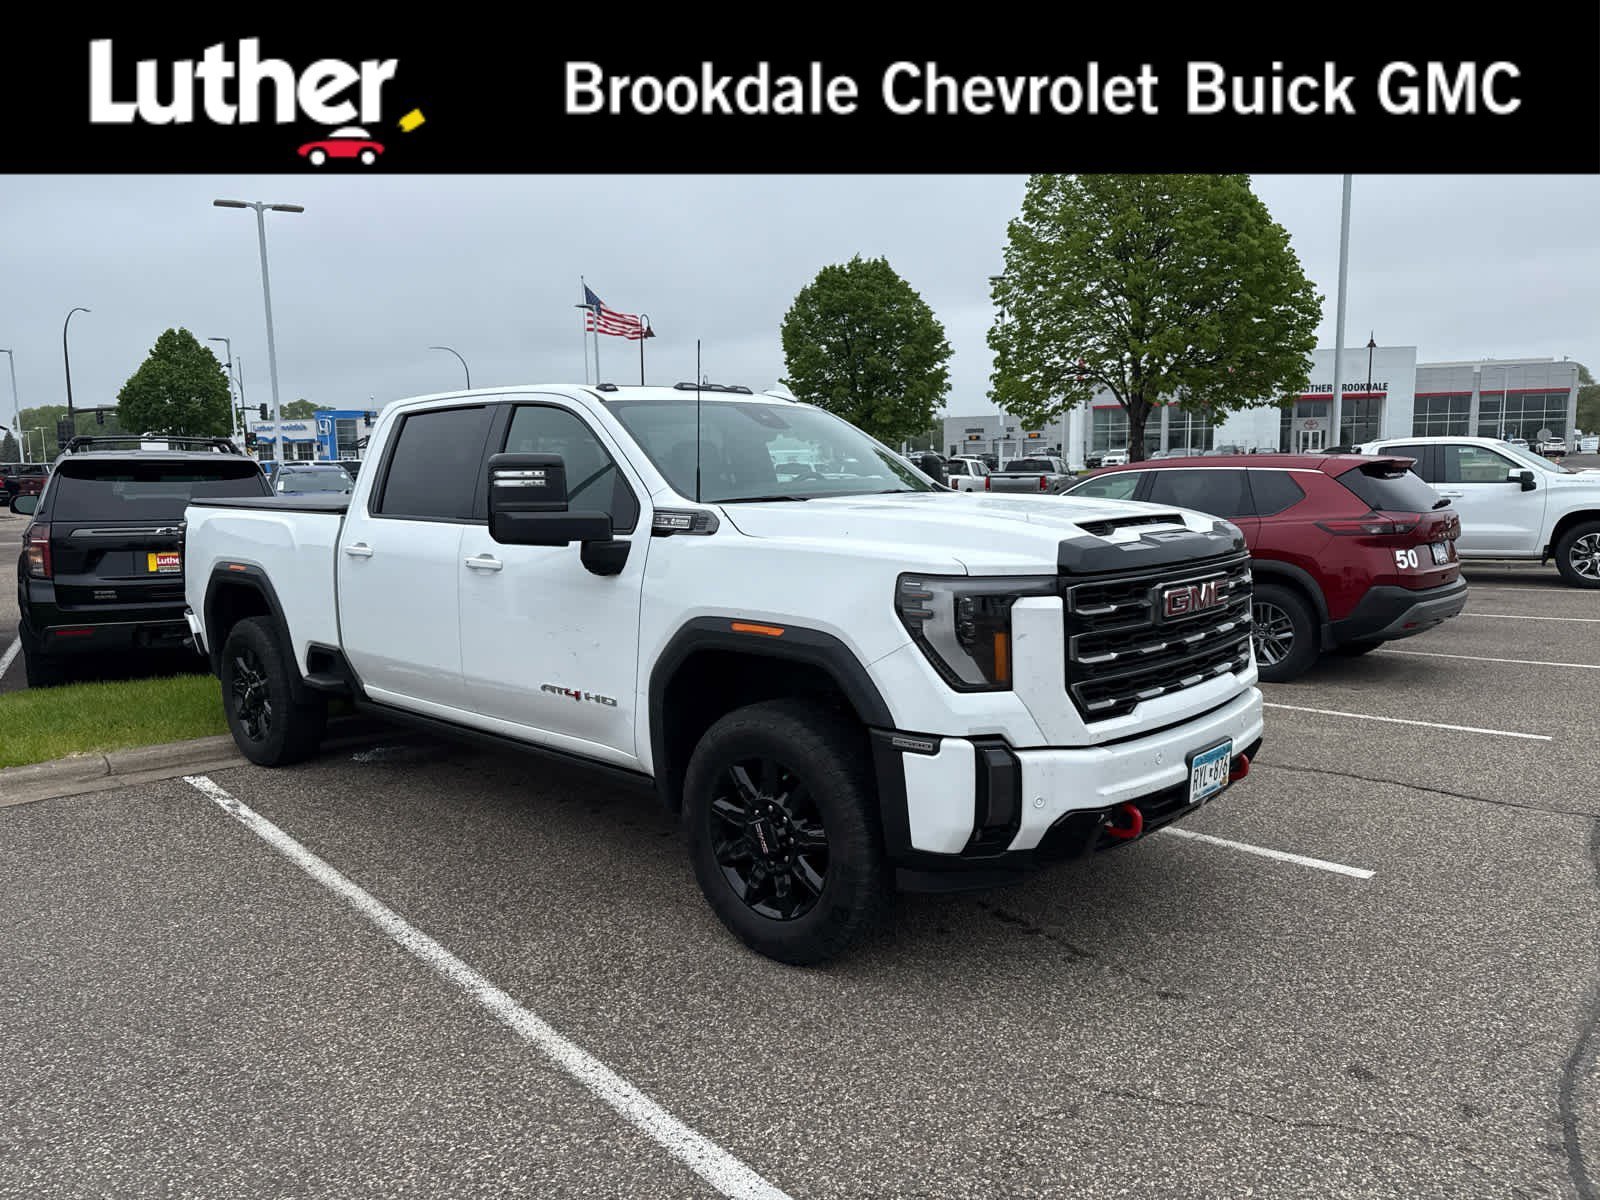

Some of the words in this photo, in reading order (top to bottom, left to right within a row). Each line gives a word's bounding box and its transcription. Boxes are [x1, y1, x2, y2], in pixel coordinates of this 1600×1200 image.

[1341, 382, 1389, 392] ROOKDALE
[157, 557, 180, 565] Luthe
[1395, 549, 1418, 569] 50
[1164, 581, 1229, 617] GMC
[584, 693, 617, 706] HD
